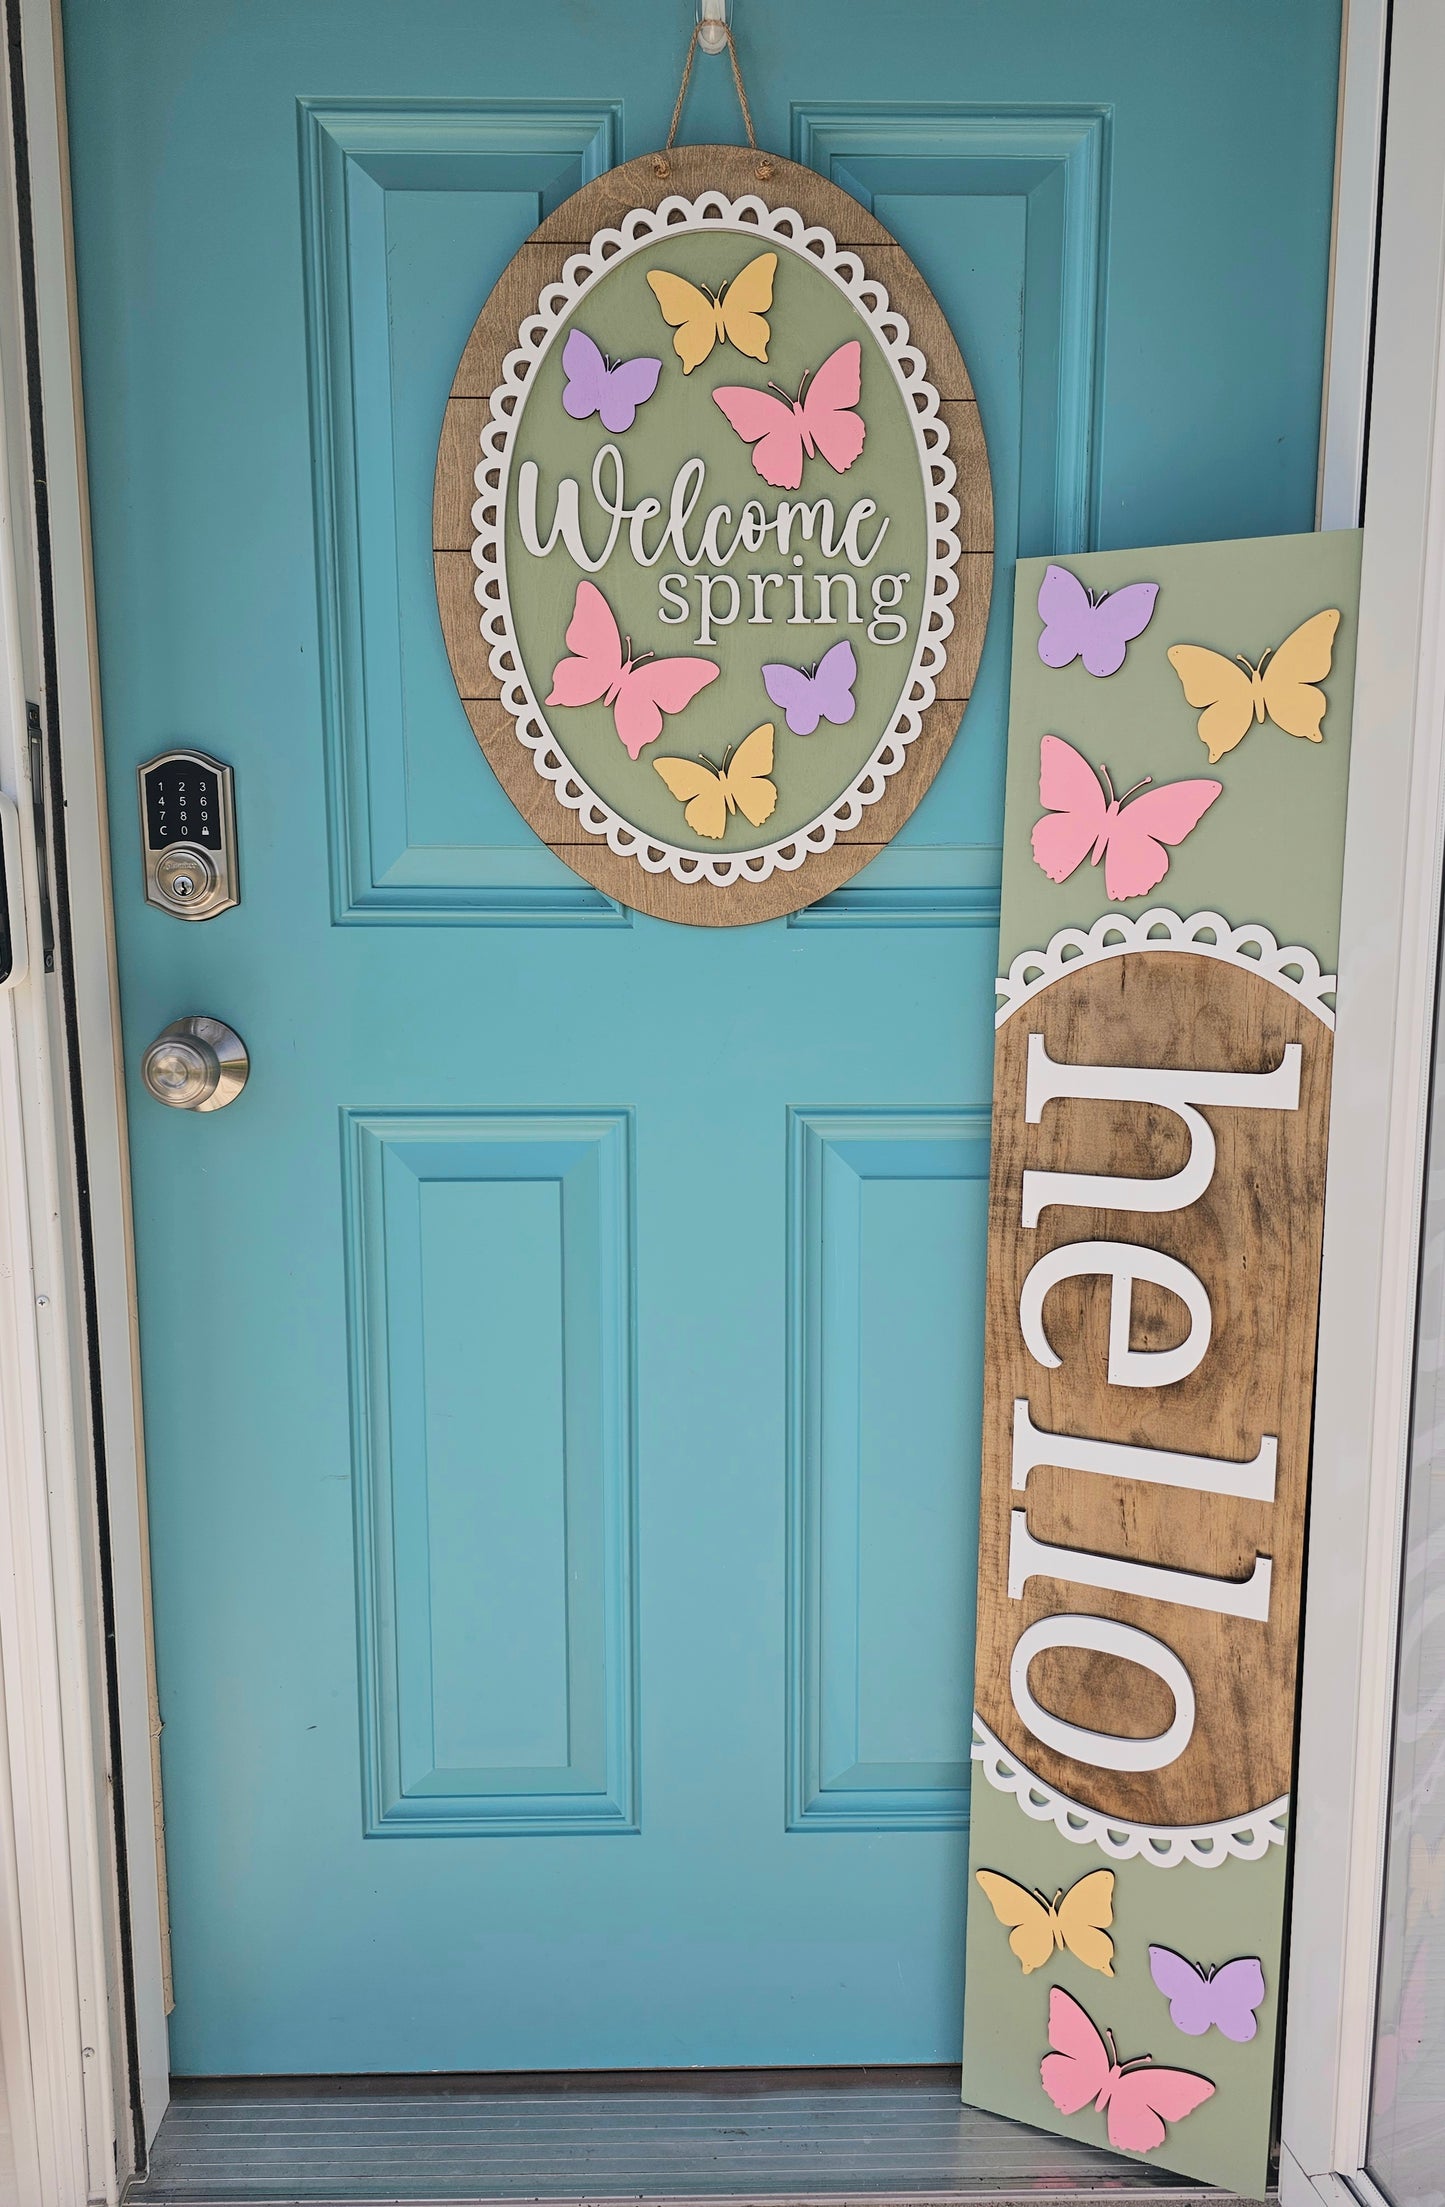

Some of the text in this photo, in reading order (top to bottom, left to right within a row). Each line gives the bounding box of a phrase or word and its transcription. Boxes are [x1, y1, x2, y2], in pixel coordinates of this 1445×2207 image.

[518, 443, 890, 573] Welcome
[657, 555, 911, 646] spring
[158, 782, 206, 792] 1 2 3
[158, 797, 207, 806] 4 5 6
[160, 811, 208, 821] 7 8 9
[160, 826, 188, 835] C 0
[1008, 1032, 1303, 1773] hello
